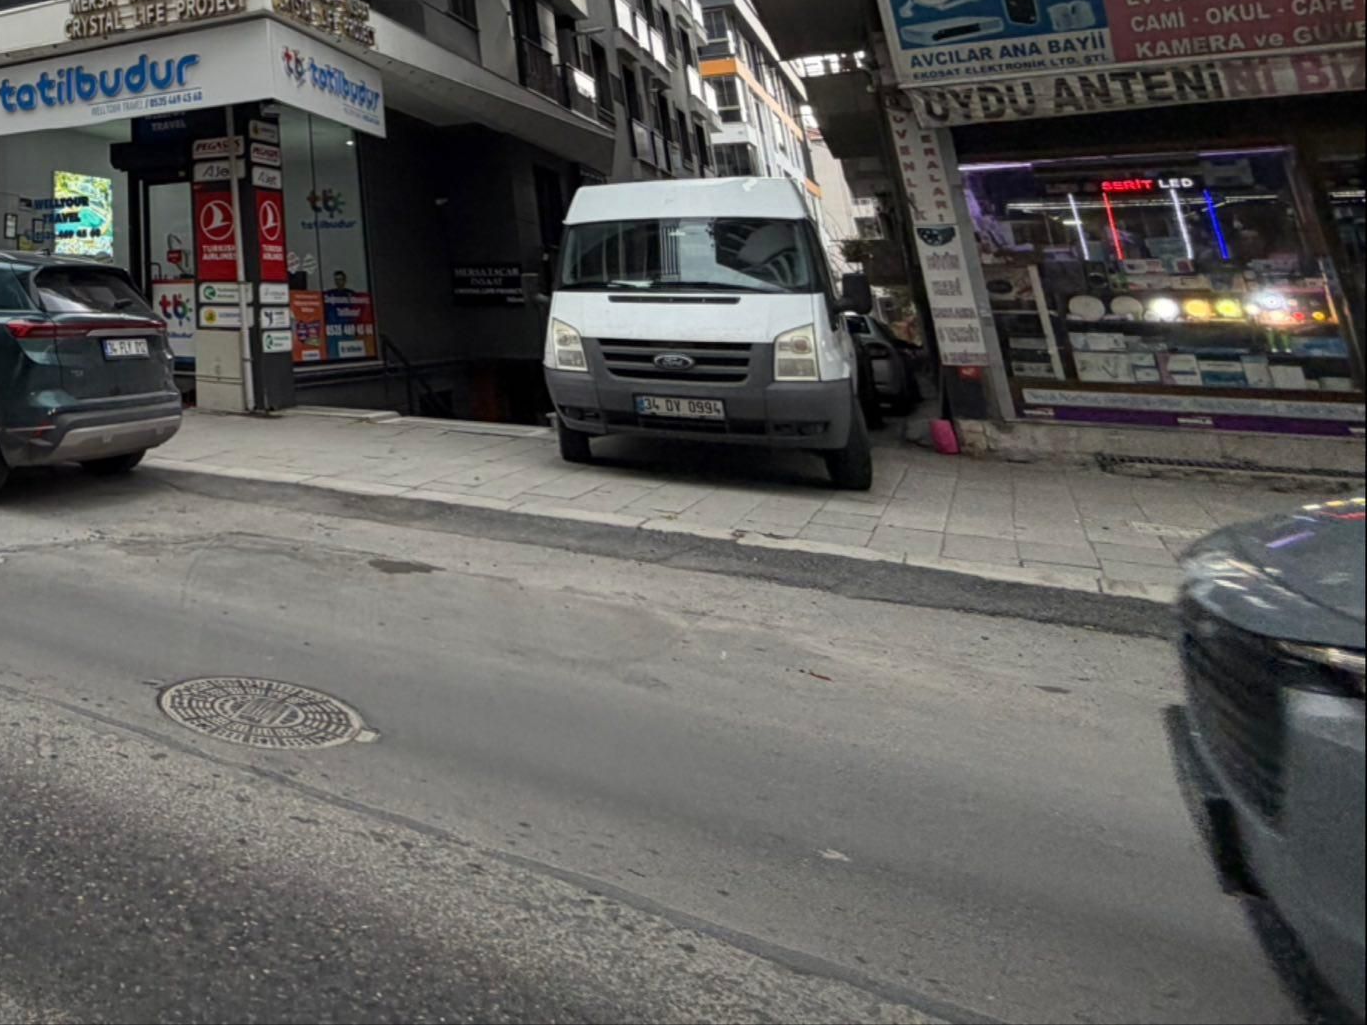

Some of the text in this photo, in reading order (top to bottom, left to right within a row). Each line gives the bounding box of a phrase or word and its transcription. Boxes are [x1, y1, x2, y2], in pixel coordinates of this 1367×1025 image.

[64, 12, 123, 39] CRYSTAL
[133, 3, 166, 26] LIFE
[1206, 2, 1270, 24] OKUL
[910, 46, 993, 68] AVCILAR
[999, 41, 1041, 58] ANA
[1135, 33, 1245, 58] KAMERA
[308, 56, 380, 113] tatilbudur
[1158, 177, 1193, 188] LED
[644, 398, 660, 410] 34
